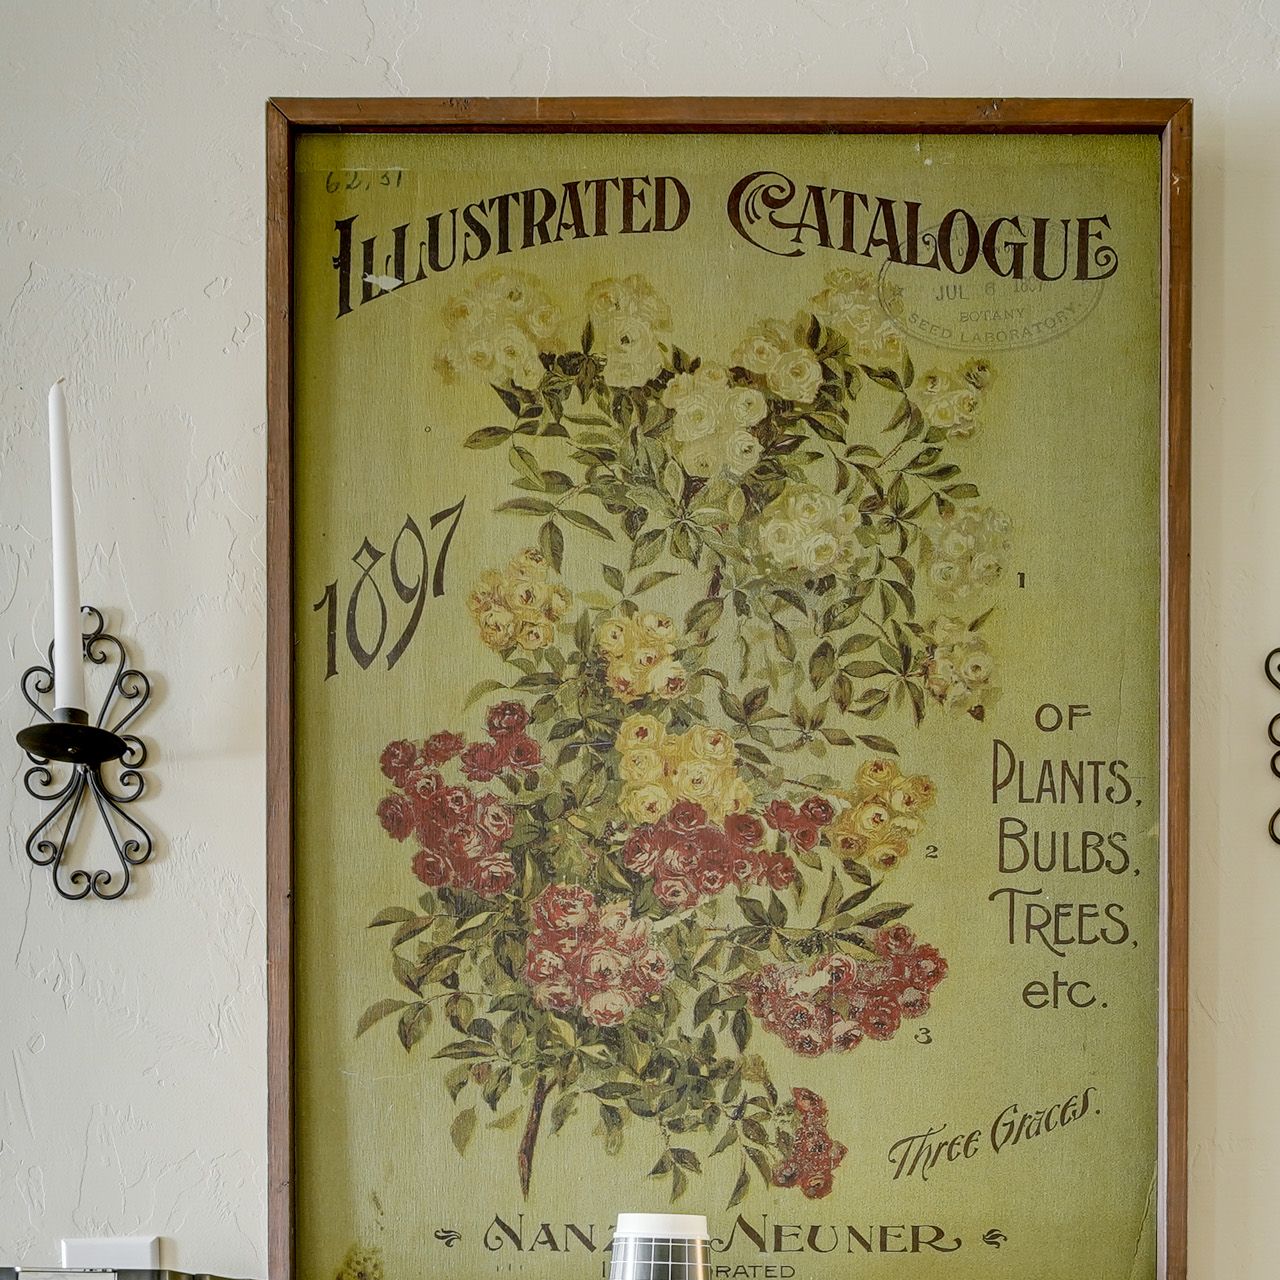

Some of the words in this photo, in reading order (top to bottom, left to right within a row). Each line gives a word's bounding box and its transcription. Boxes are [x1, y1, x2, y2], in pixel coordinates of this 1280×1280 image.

[332, 174, 691, 320] ILLUSTRATED
[726, 170, 1119, 282] CATALOGUE
[935, 284, 969, 302] JUL
[908, 312, 953, 340] SEED
[959, 308, 1026, 323] BOTANY
[313, 494, 467, 682] 1897
[1016, 572, 1026, 589] 1
[1034, 702, 1092, 733] OF
[991, 738, 1143, 807] PLANTS,
[924, 844, 939, 860] 2
[998, 816, 1141, 877] BULBS,
[987, 887, 1139, 958] TREES,
[1021, 970, 1109, 1010] etc.
[913, 1026, 933, 1045] 3
[887, 1122, 983, 1182] Three
[990, 1085, 1102, 1155] Graces.
[709, 1213, 963, 1254] NEUNER
